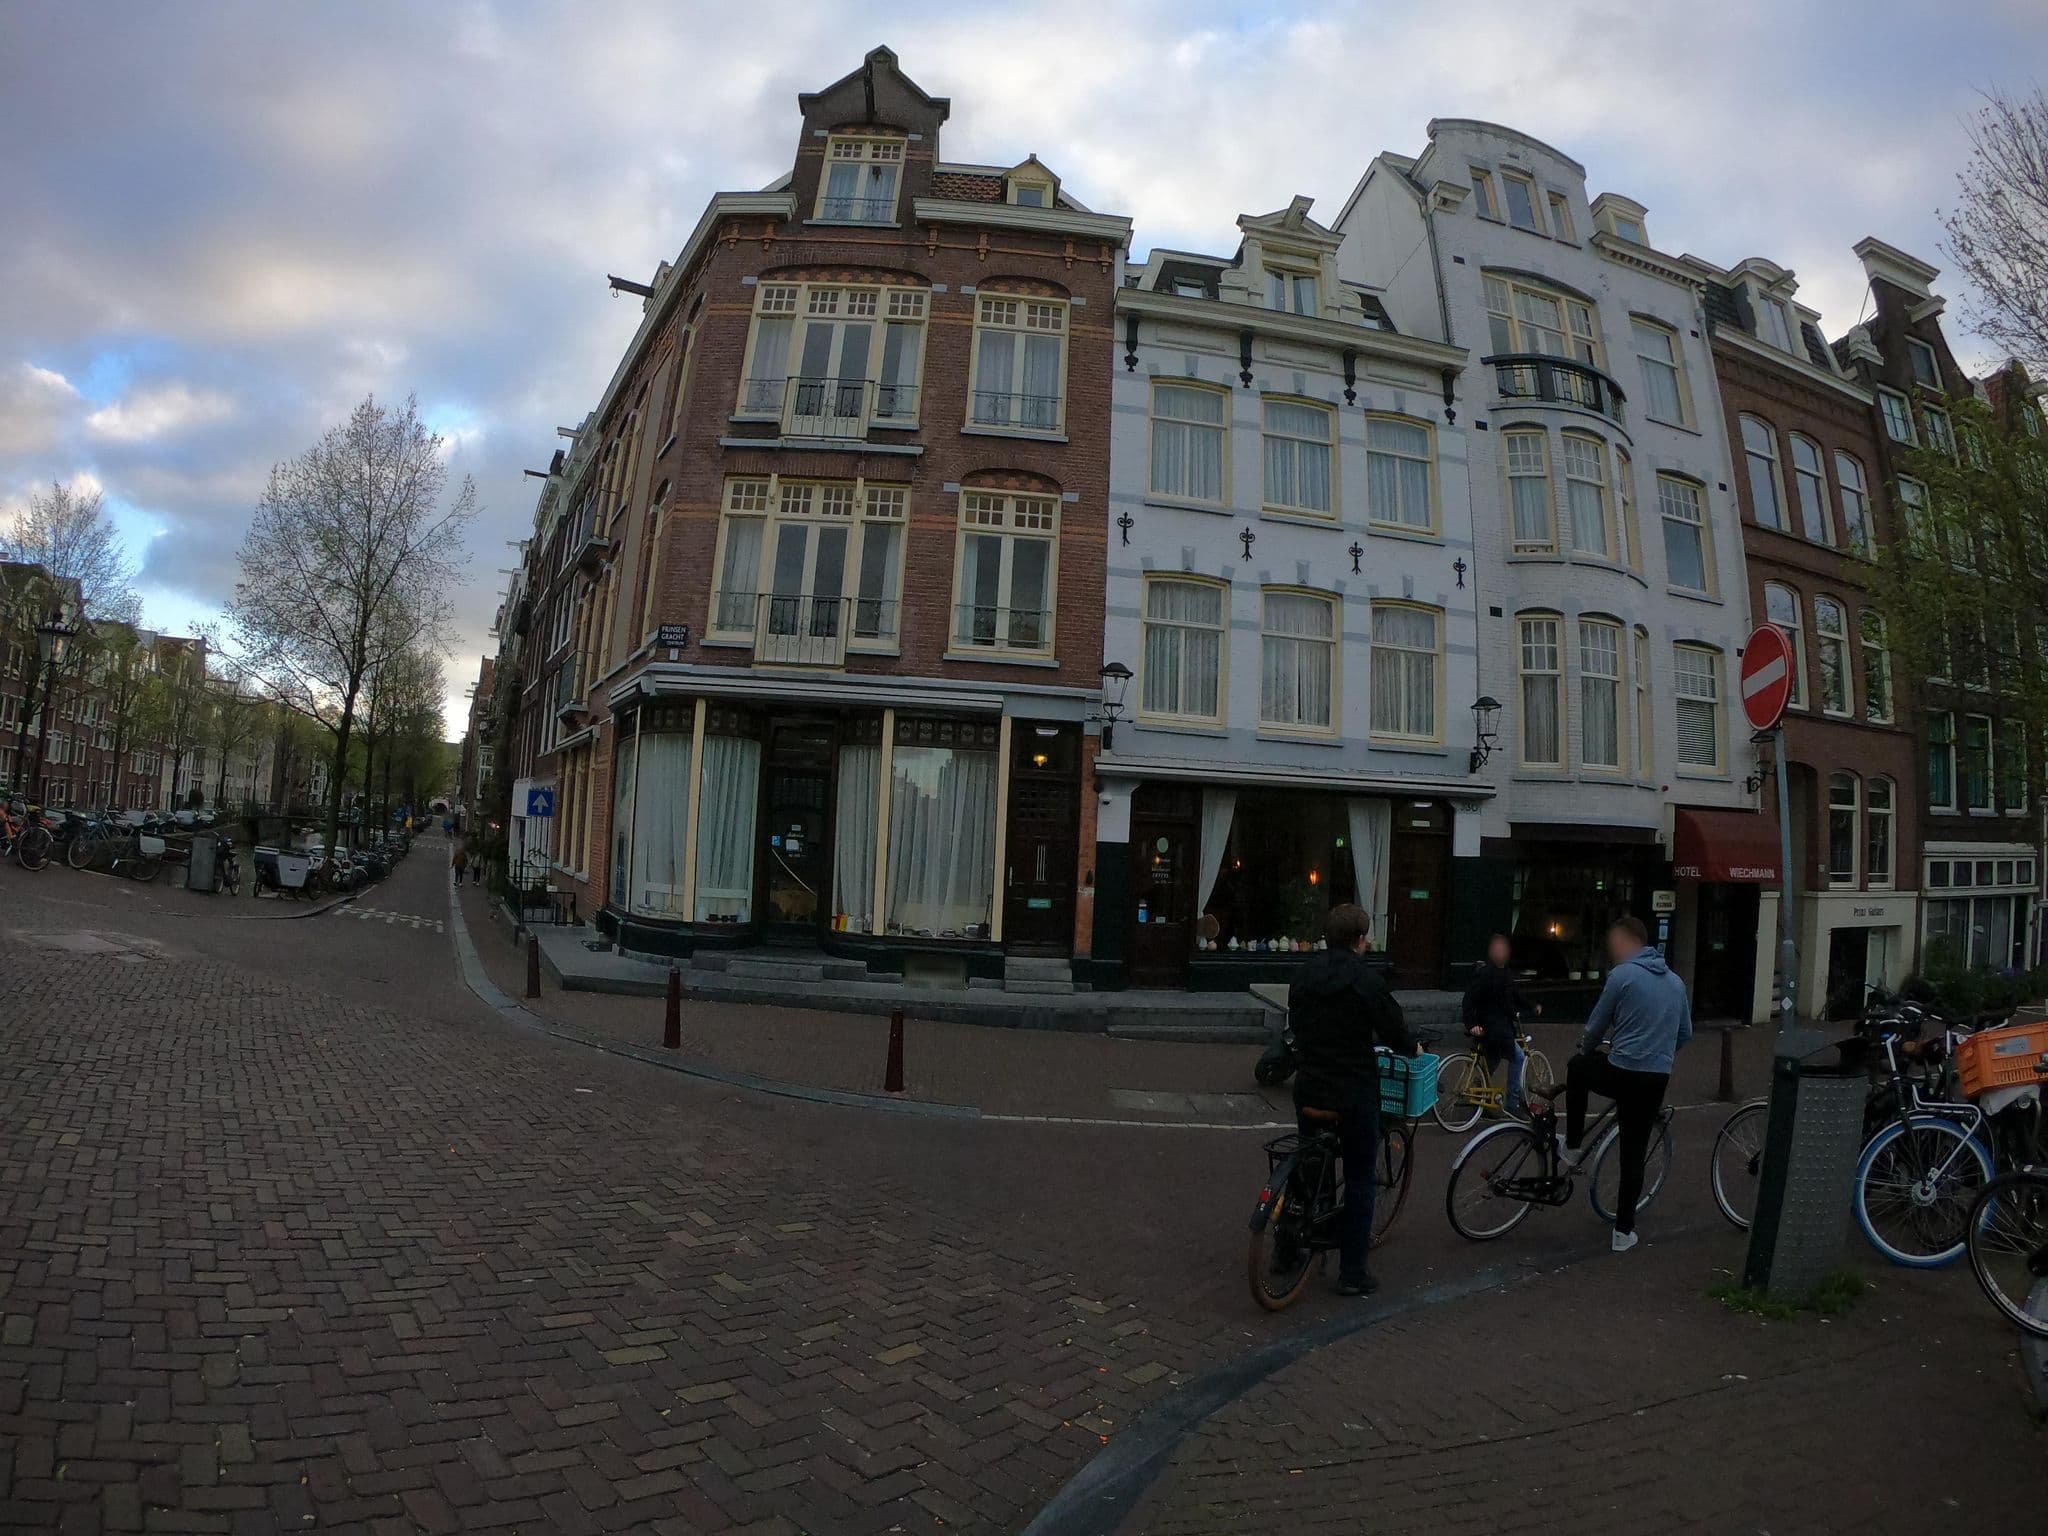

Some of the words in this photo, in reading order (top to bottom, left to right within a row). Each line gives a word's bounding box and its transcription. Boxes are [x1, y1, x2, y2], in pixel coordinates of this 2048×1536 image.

[661, 625, 686, 633] PRINSEN
[1674, 866, 1701, 876] HOTEL
[1729, 867, 1775, 879] WIECHMANN
